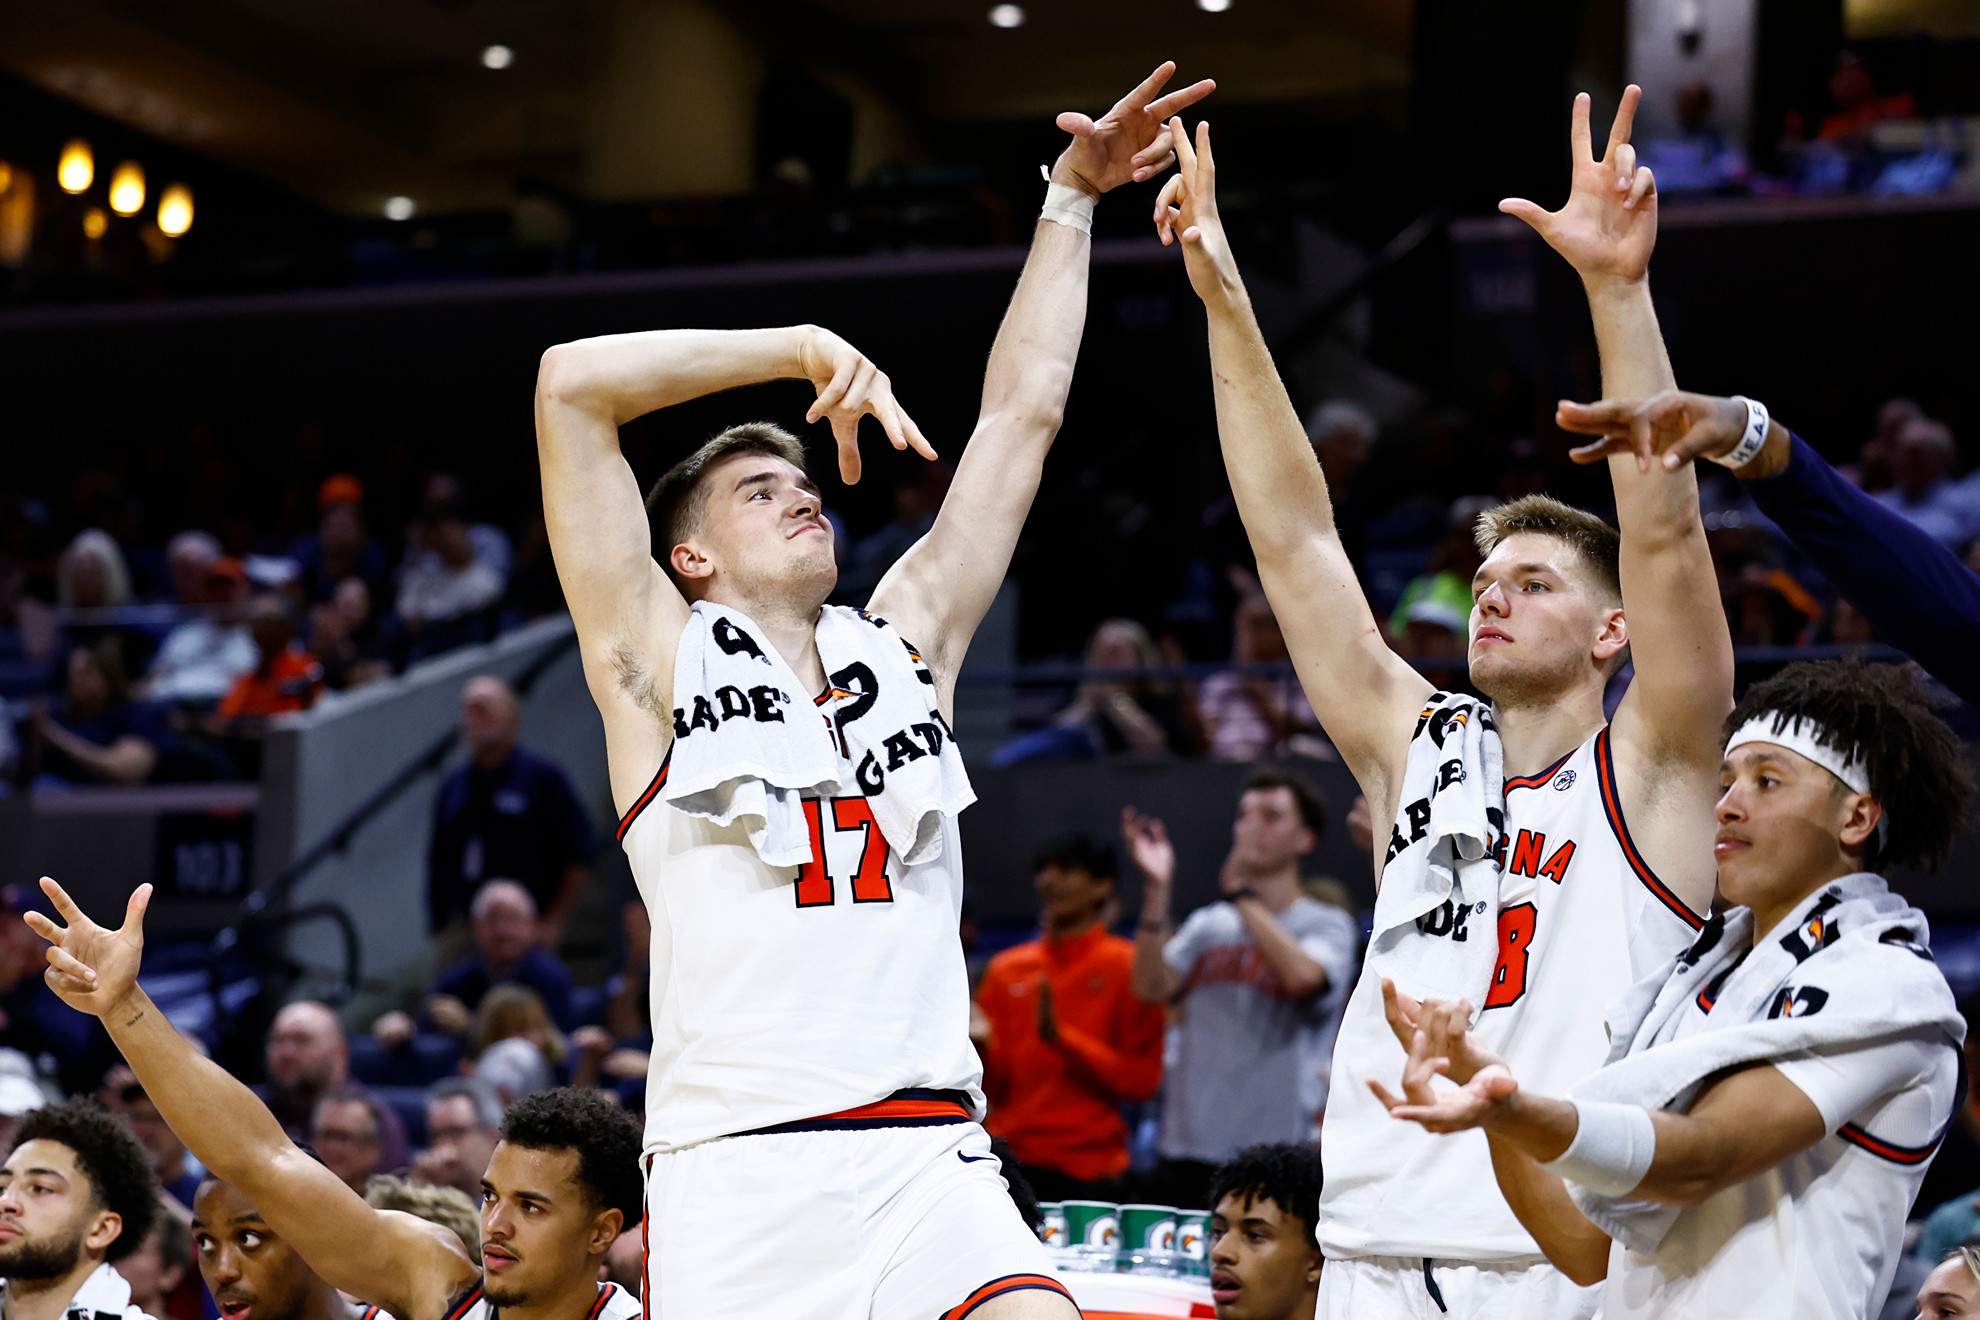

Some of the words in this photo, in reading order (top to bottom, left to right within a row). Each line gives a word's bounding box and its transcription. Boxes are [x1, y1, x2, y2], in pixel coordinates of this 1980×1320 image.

[794, 796, 895, 908] 17
[1484, 901, 1538, 1010] 8
[1177, 1223, 1204, 1261] G
